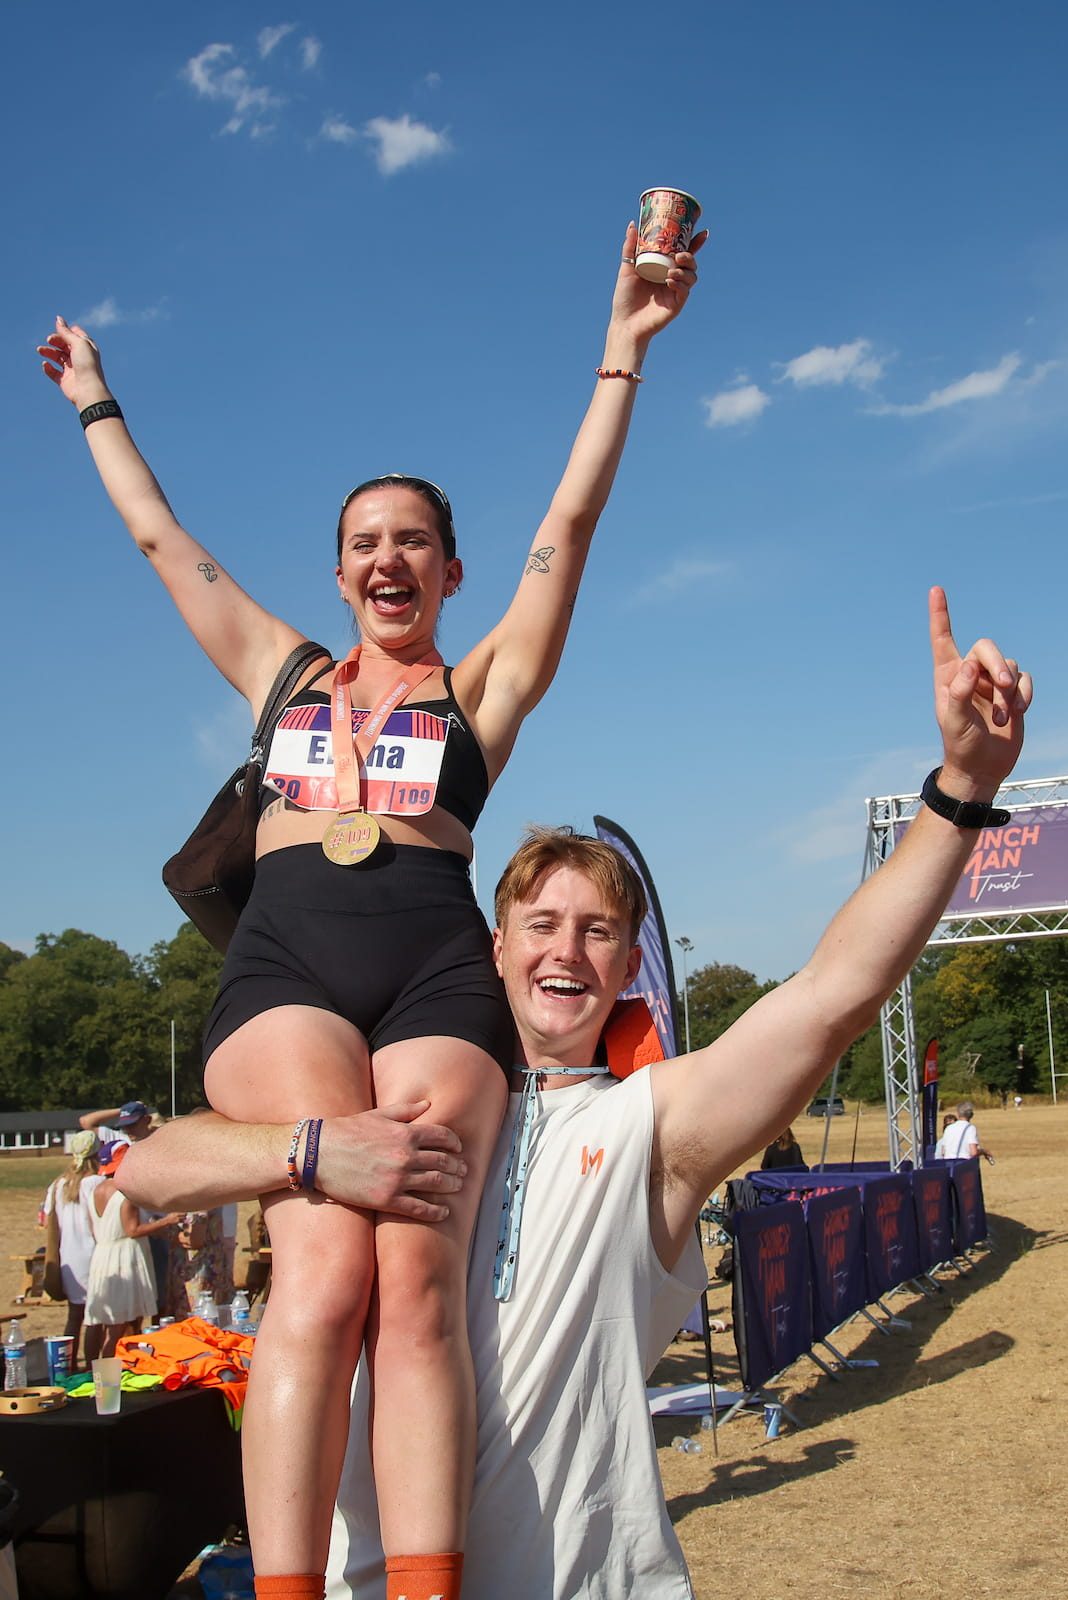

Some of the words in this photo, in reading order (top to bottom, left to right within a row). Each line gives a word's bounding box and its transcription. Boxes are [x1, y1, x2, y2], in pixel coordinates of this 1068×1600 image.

[398, 788, 431, 805] 109
[973, 824, 1040, 851] NCH
[970, 870, 1034, 903] Trust
[580, 1144, 605, 1179] M
